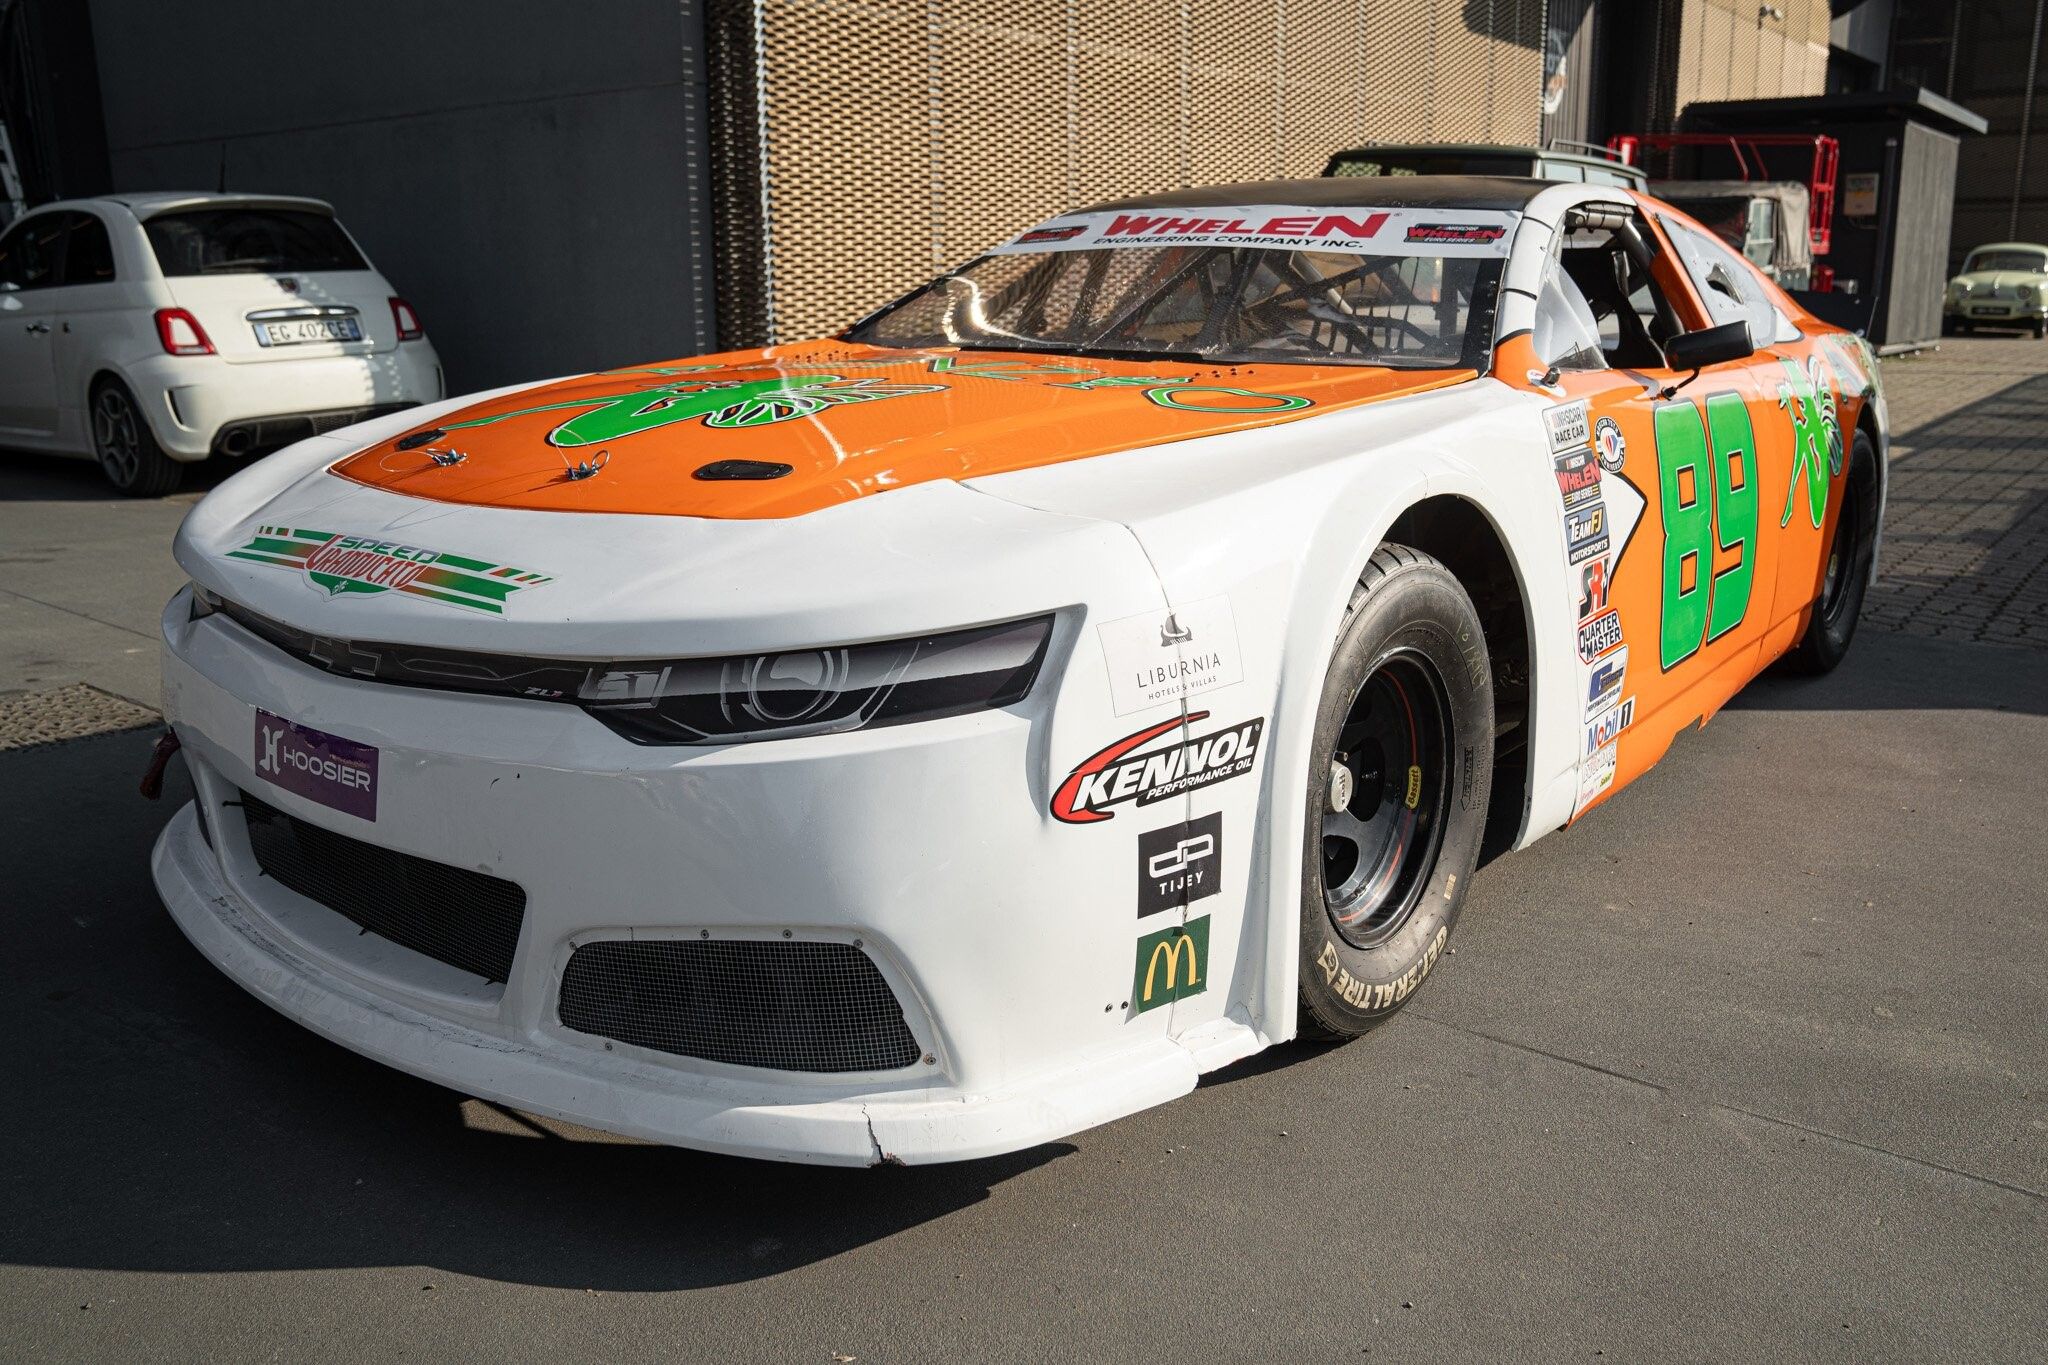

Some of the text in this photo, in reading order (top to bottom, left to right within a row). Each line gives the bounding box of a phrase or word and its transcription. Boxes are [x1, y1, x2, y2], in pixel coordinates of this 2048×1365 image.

[1093, 236, 1364, 248] ENGINEERING COMPANY INC.
[1103, 213, 1391, 238] WHELEN
[1408, 227, 1506, 239] WHELEN
[1553, 407, 1582, 428] NASCAR
[1555, 425, 1585, 444] RACE CAR
[1555, 457, 1601, 495] WHELEN
[1653, 391, 1758, 671] 89
[336, 535, 441, 564] SPEED
[1571, 539, 1608, 563] MOTORSPORTS
[1579, 613, 1617, 652] QUARTER
[1586, 627, 1621, 660] MASTER
[1136, 652, 1221, 688] LIBURNIA
[1148, 685, 1180, 700] HOTELS
[1190, 675, 1217, 688] VILLAS
[1587, 700, 1632, 755] Mobil 1
[283, 745, 371, 792] HOOSIER
[1070, 725, 1255, 813] KENNOL
[1146, 757, 1253, 801] PERFORMANCE OIL
[1408, 769, 1419, 804] Bassett
[1159, 870, 1203, 895] TIJEY
[1332, 967, 1373, 1009] TIRE
